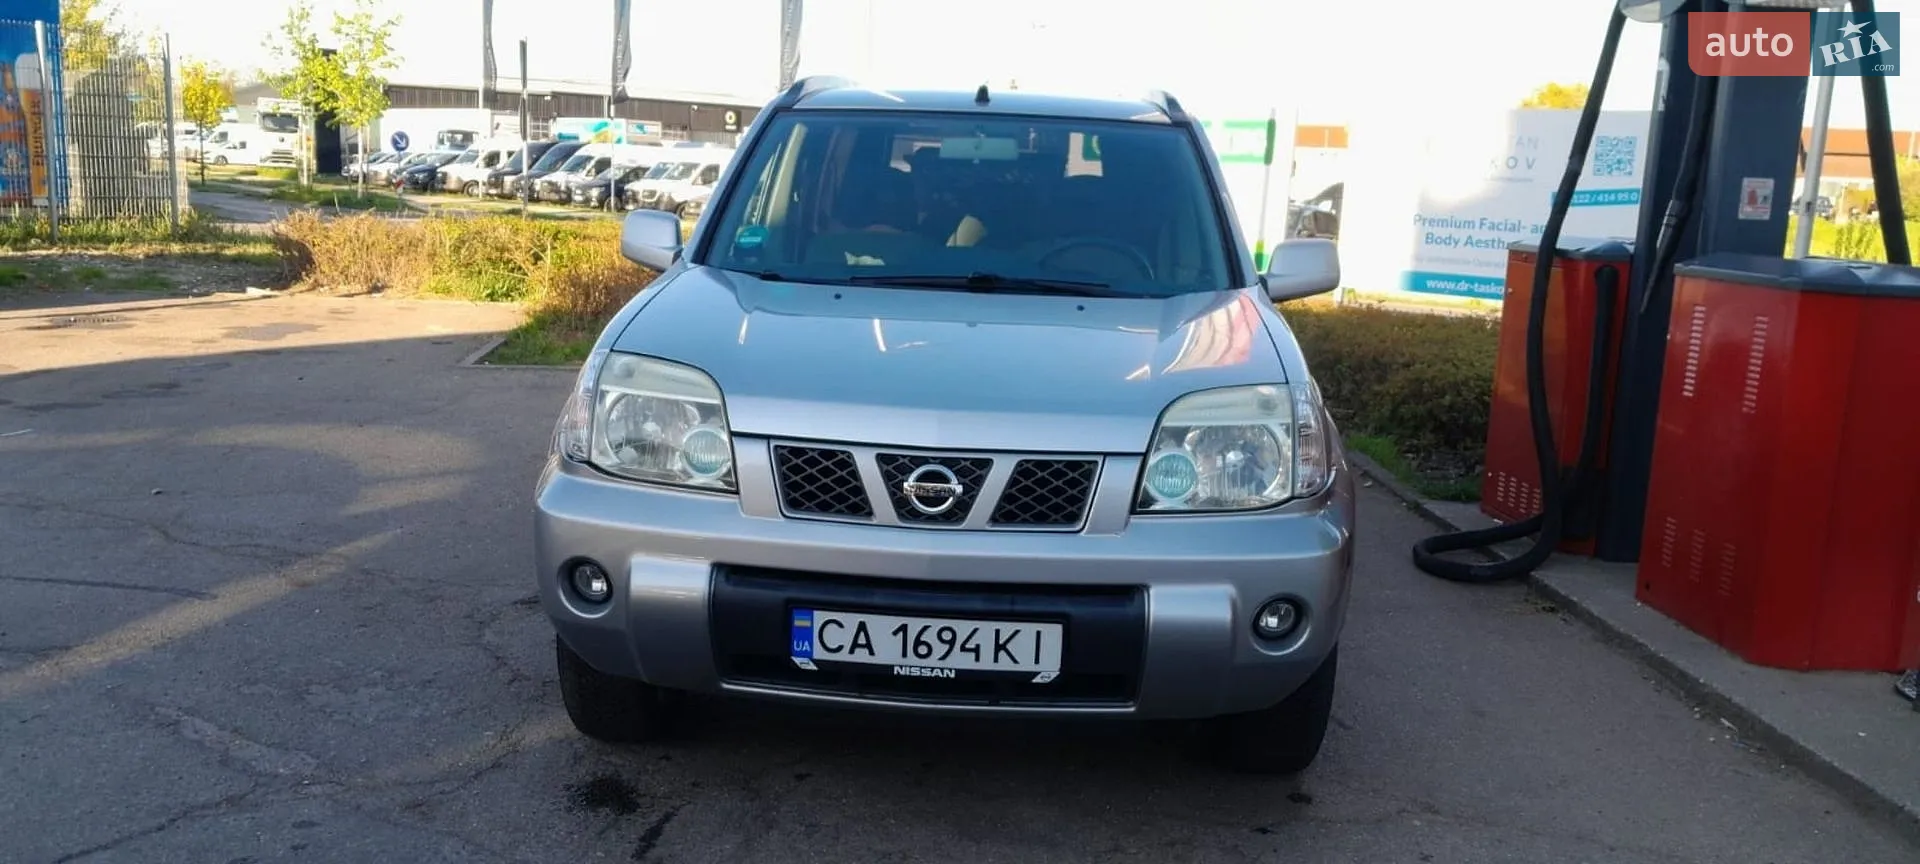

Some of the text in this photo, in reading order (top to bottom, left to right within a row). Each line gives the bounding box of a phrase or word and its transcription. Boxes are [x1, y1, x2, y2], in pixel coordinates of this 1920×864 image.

[1413, 214, 1476, 229] Premium
[1479, 218, 1526, 233] Facial-
[1425, 232, 1507, 250] Body Aesth
[1426, 280, 1505, 294] www.dr-tasko
[793, 640, 811, 652] UA
[818, 618, 875, 657] CA
[891, 622, 980, 662] 1694
[893, 666, 956, 679] NISSAN
